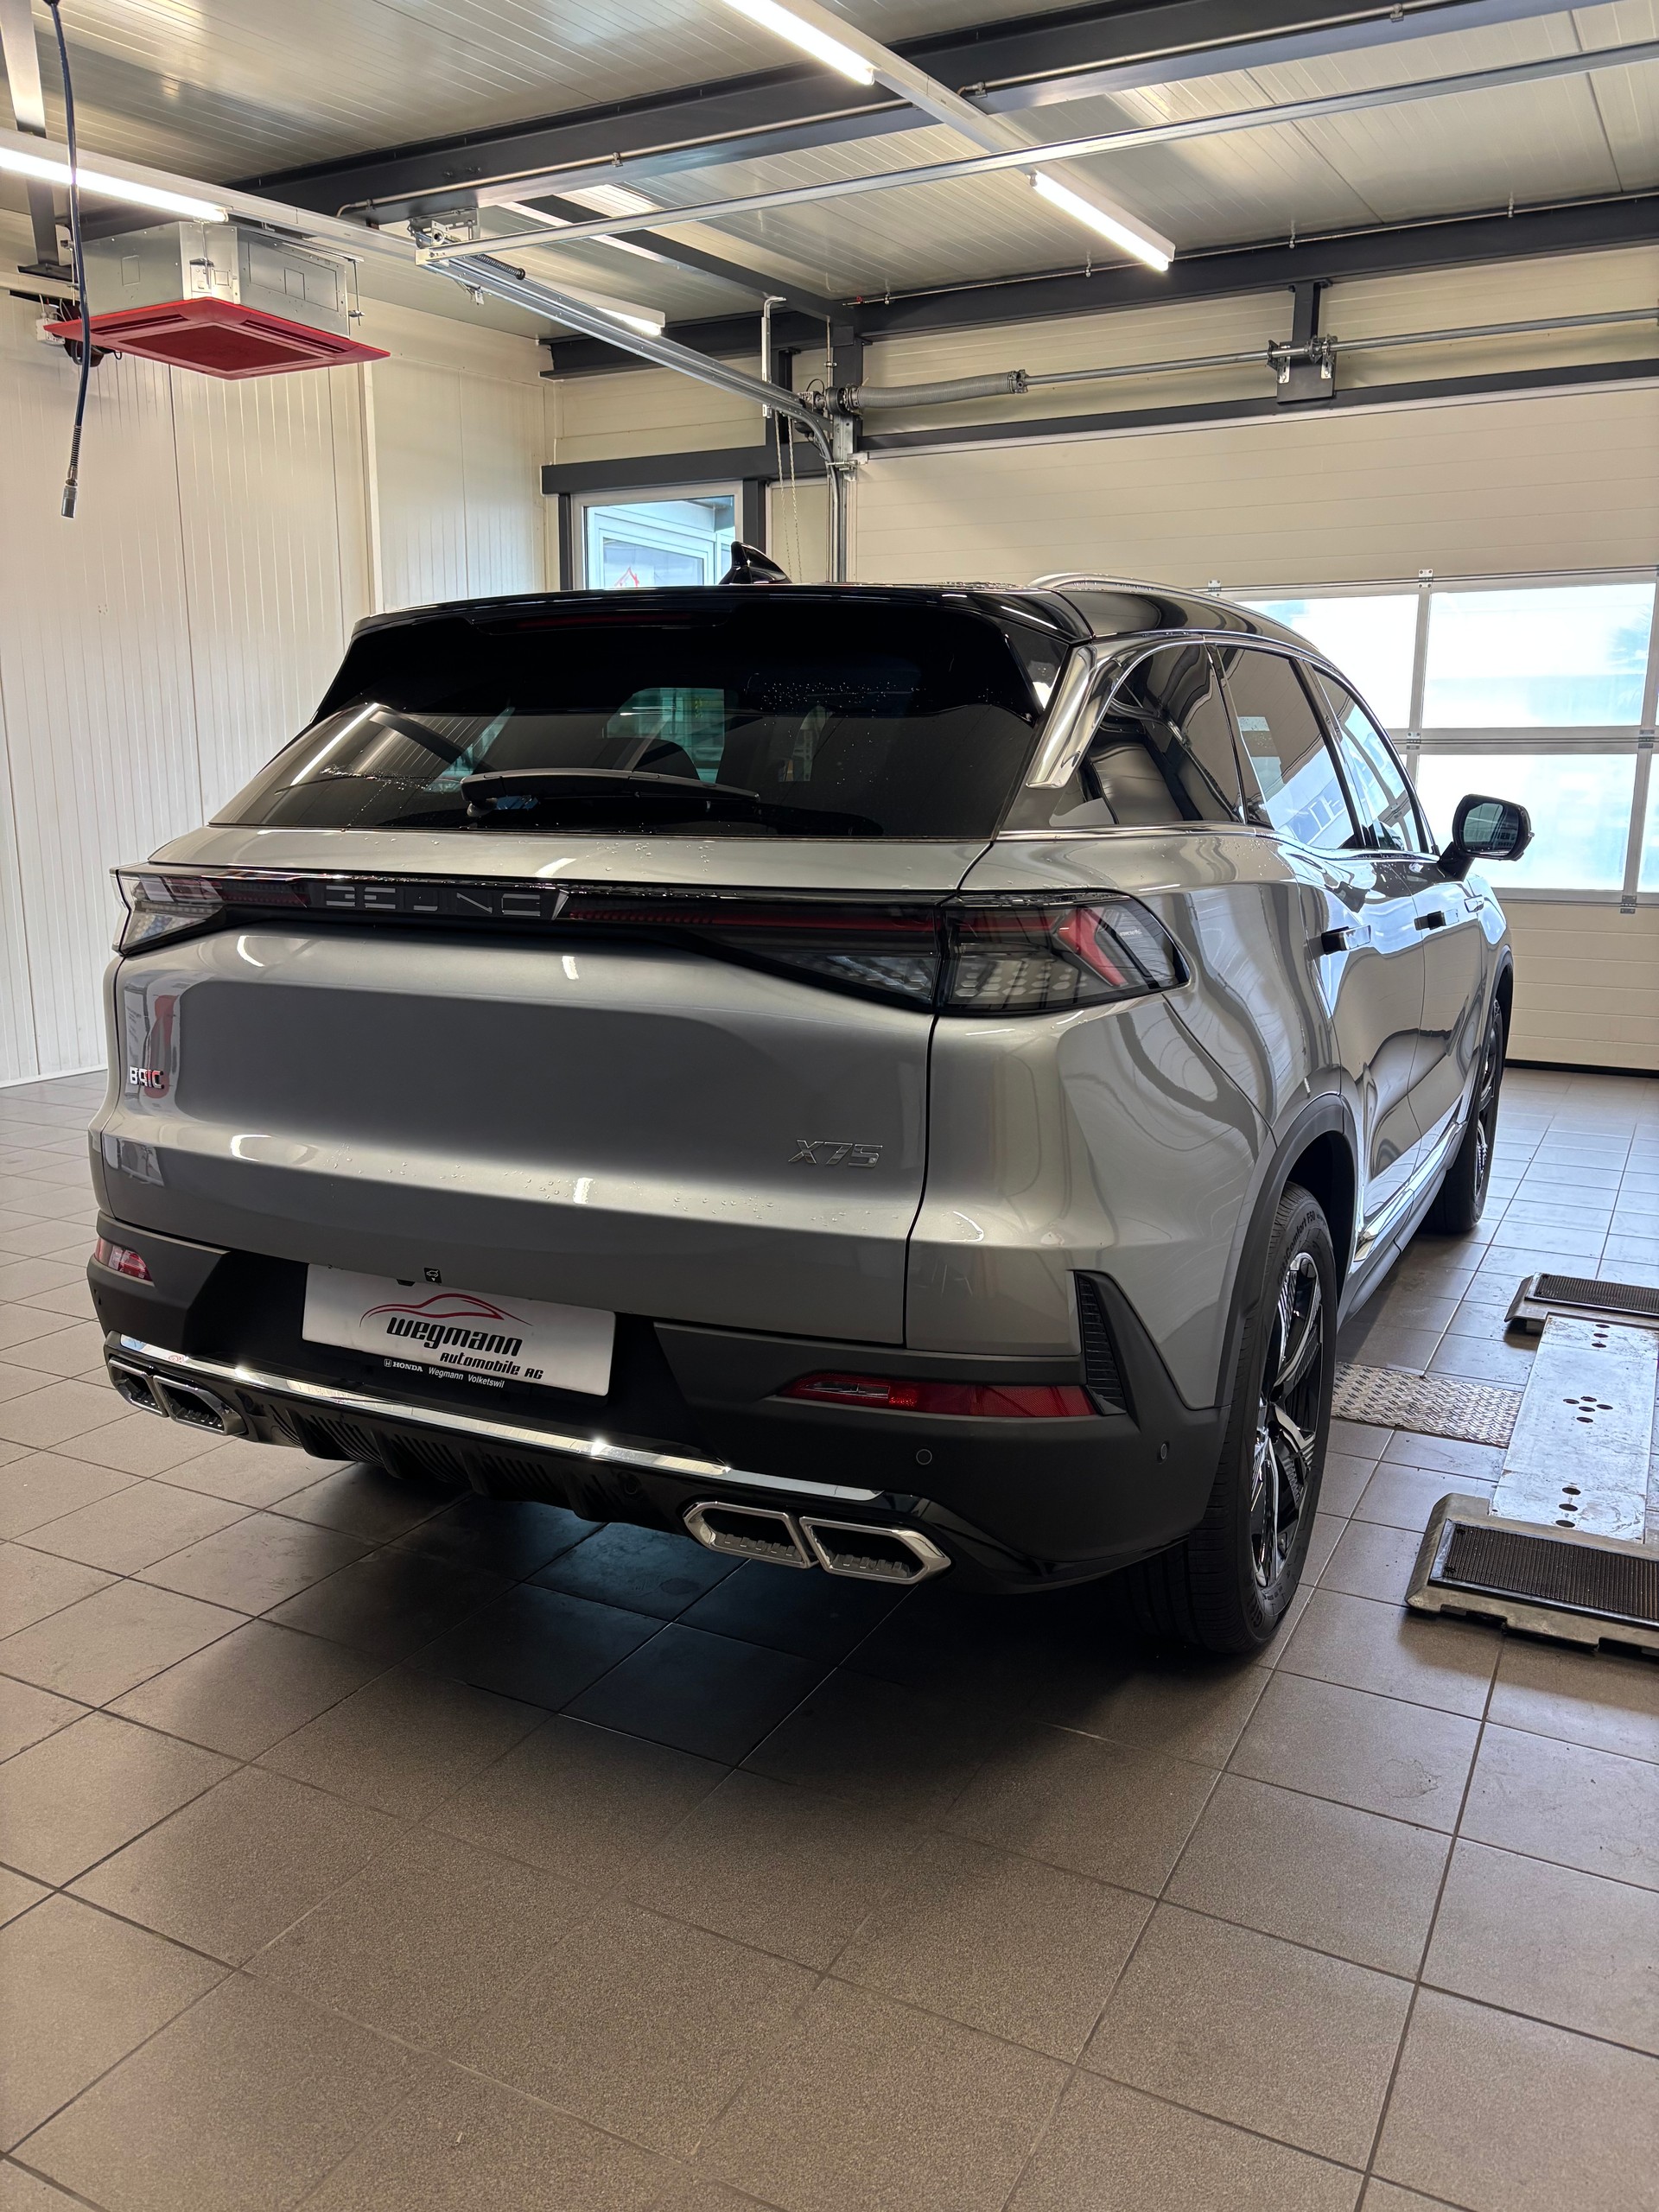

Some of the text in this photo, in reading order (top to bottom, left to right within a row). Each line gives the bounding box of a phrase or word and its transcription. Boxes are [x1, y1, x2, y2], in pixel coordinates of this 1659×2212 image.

[130, 1065, 164, 1089] BAIC
[788, 1139, 883, 1168] X75
[386, 1317, 523, 1357] wegmann
[392, 1360, 505, 1389] HONDA Wegmann Volketswil
[524, 1367, 544, 1380] AG
